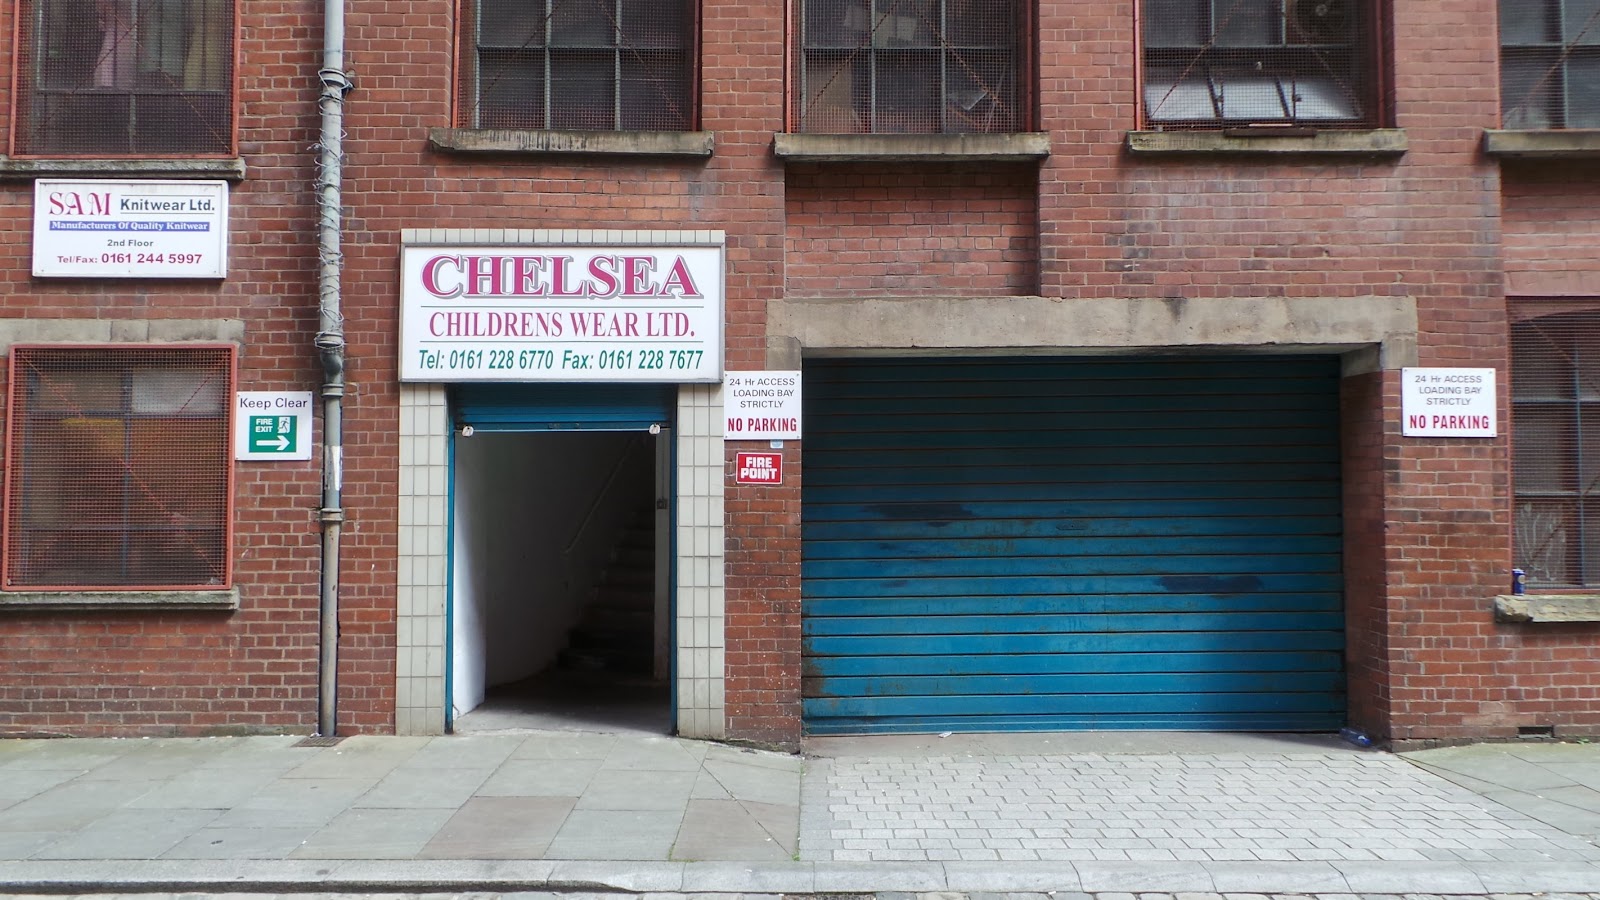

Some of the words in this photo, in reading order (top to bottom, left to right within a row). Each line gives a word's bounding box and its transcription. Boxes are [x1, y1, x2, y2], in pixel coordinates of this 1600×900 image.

[49, 192, 111, 216] SAM
[120, 199, 184, 211] Knitwear
[190, 199, 215, 211] Ltd.
[52, 221, 116, 230] Manufacturers
[118, 221, 129, 230] Of
[130, 222, 164, 232] Quality
[166, 222, 208, 230] Knitwear
[107, 239, 126, 247] 2nd
[58, 256, 98, 264] Tel/Fax:
[102, 253, 132, 264] 0161
[137, 254, 164, 264] 244
[168, 254, 202, 264] 5997
[420, 254, 704, 300] CHELSEA
[429, 312, 563, 337] CHILDRENS
[570, 312, 639, 337] WEAR
[645, 312, 695, 337] LTD.
[419, 350, 445, 370] Tel:
[449, 350, 483, 370] 0161
[488, 350, 514, 370] 228
[518, 350, 554, 370] 6770
[562, 350, 593, 370] Fax:
[599, 350, 633, 370] 0161
[638, 350, 664, 370] 228
[668, 350, 704, 370] 7677
[730, 378, 741, 386] 24
[745, 378, 756, 386] Hr
[757, 378, 796, 386] ACCESS
[1444, 376, 1482, 384] ACCESS
[734, 389, 774, 398] LOADING
[777, 389, 794, 397] BAY
[1420, 386, 1462, 394] LOADING
[240, 398, 272, 410] Keep
[276, 398, 308, 408] Clear
[740, 400, 784, 408] STRICTLY
[1426, 398, 1471, 406] STRICTLY
[728, 418, 743, 432] NO
[748, 418, 797, 432] PARKING
[1410, 415, 1426, 429] NO
[1433, 416, 1490, 429] PARKING
[746, 456, 772, 468] FIRE
[740, 468, 778, 480] POINT
